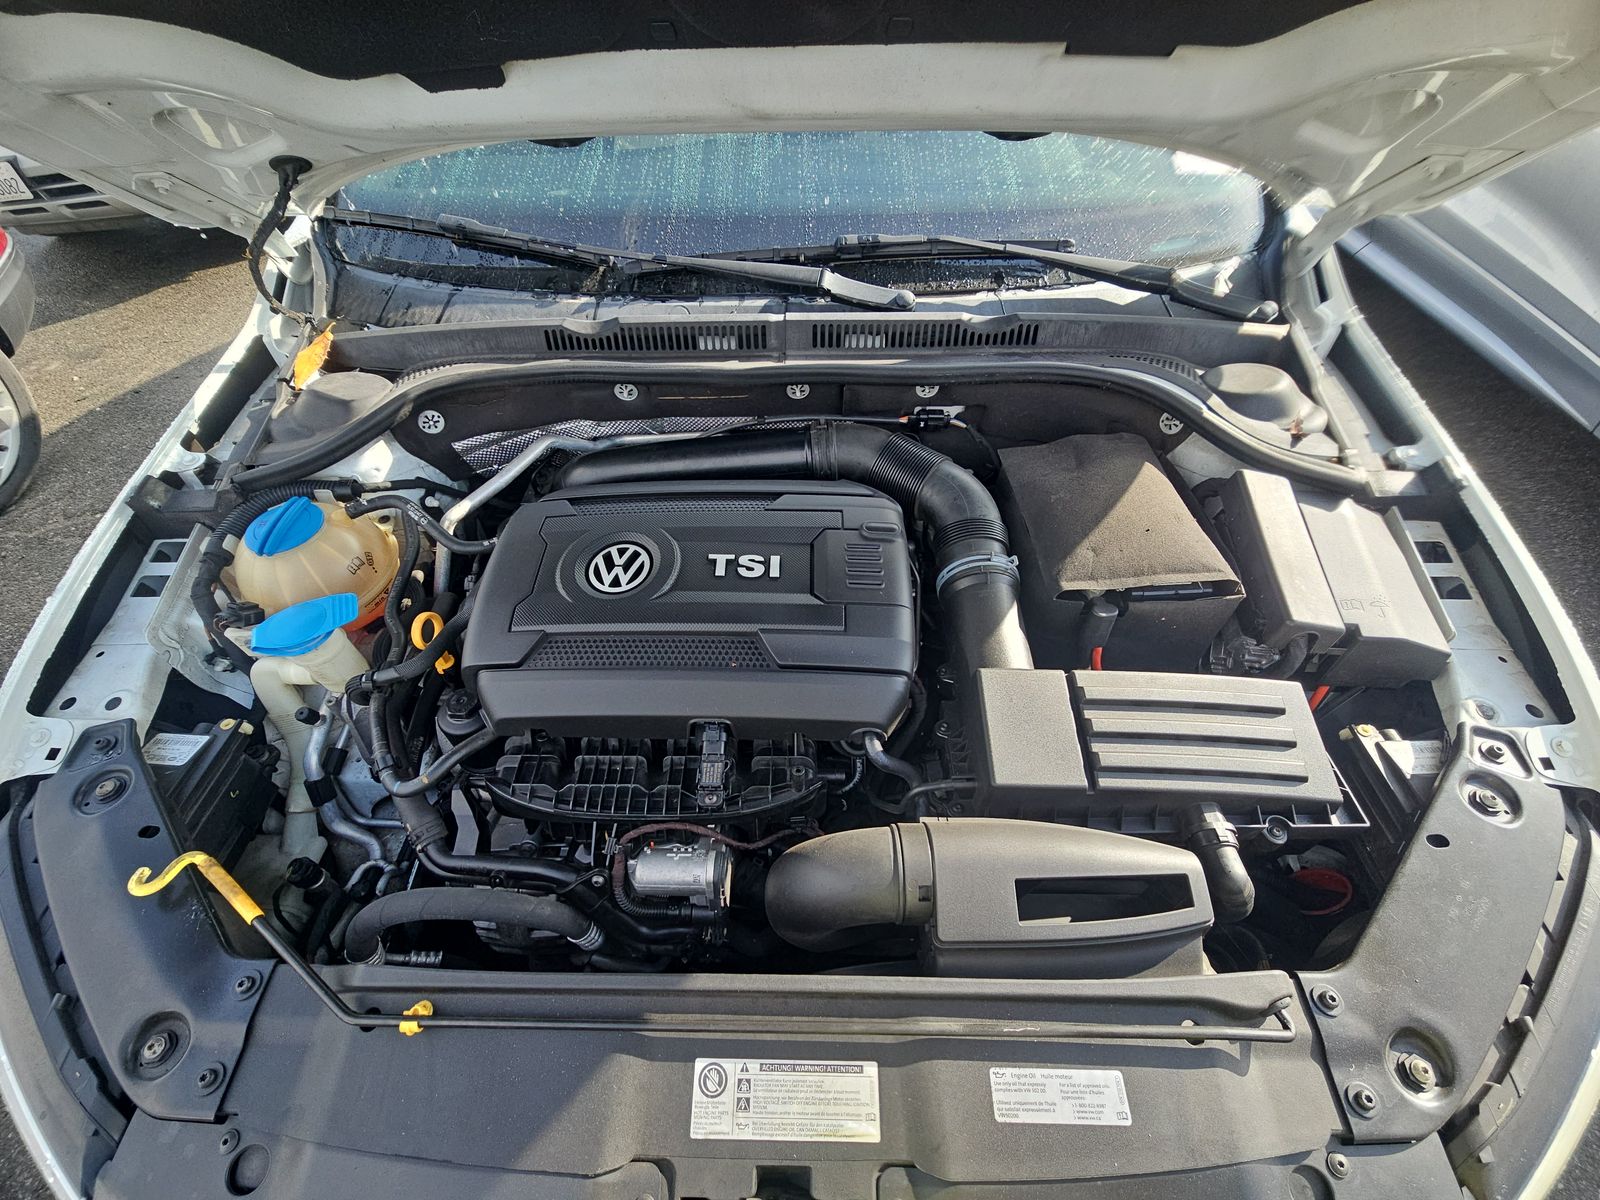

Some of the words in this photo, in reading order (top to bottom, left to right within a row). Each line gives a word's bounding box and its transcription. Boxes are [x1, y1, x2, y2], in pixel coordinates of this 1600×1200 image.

[588, 543, 651, 593] VW
[707, 553, 781, 578] TSI
[762, 1064, 793, 1072] ACHTUNG!
[1010, 1072, 1028, 1080] Engine
